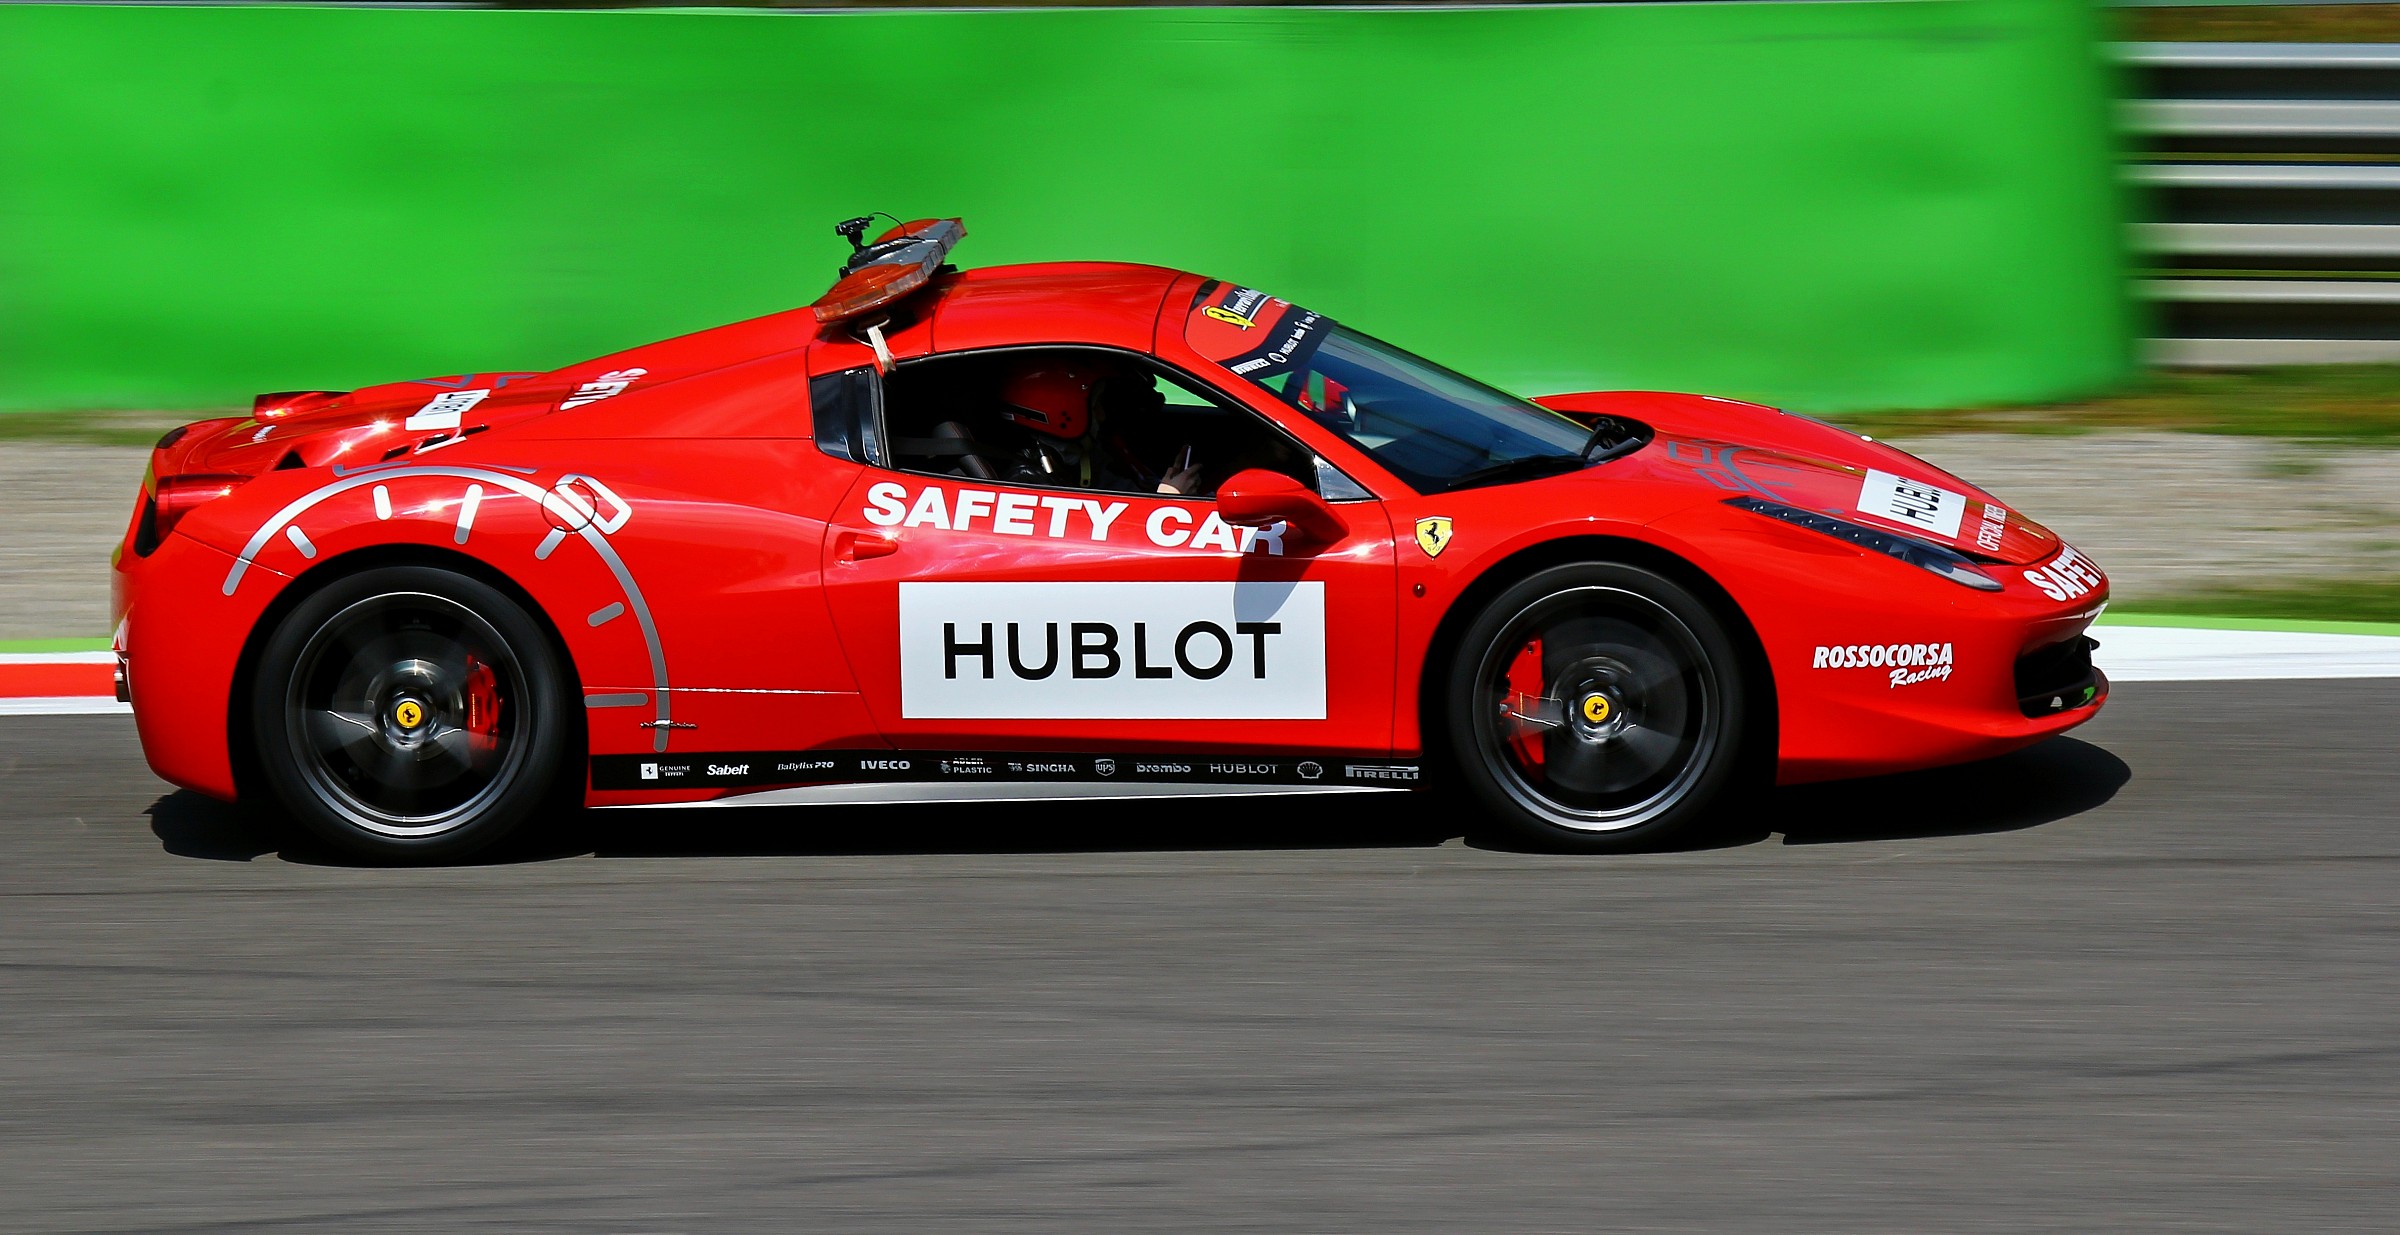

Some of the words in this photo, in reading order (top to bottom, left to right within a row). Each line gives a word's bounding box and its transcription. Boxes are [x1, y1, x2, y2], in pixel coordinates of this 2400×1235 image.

[863, 482, 1129, 541] SAFETY
[1146, 506, 1287, 556] CAR
[2023, 542, 2102, 601] SAFET
[943, 620, 1282, 680] HUBLOT
[1813, 643, 1953, 669] ROSSOCORSA
[1889, 664, 1953, 689] Racing
[706, 764, 750, 776] Sabelt
[815, 761, 834, 769] PRO
[860, 760, 911, 770] IVECO
[953, 766, 993, 774] PLASTIC
[1026, 764, 1076, 772] SINGHA
[1136, 763, 1191, 773] brembo
[1210, 763, 1279, 774] HUBLOT
[1345, 765, 1419, 779] PIRELLI
